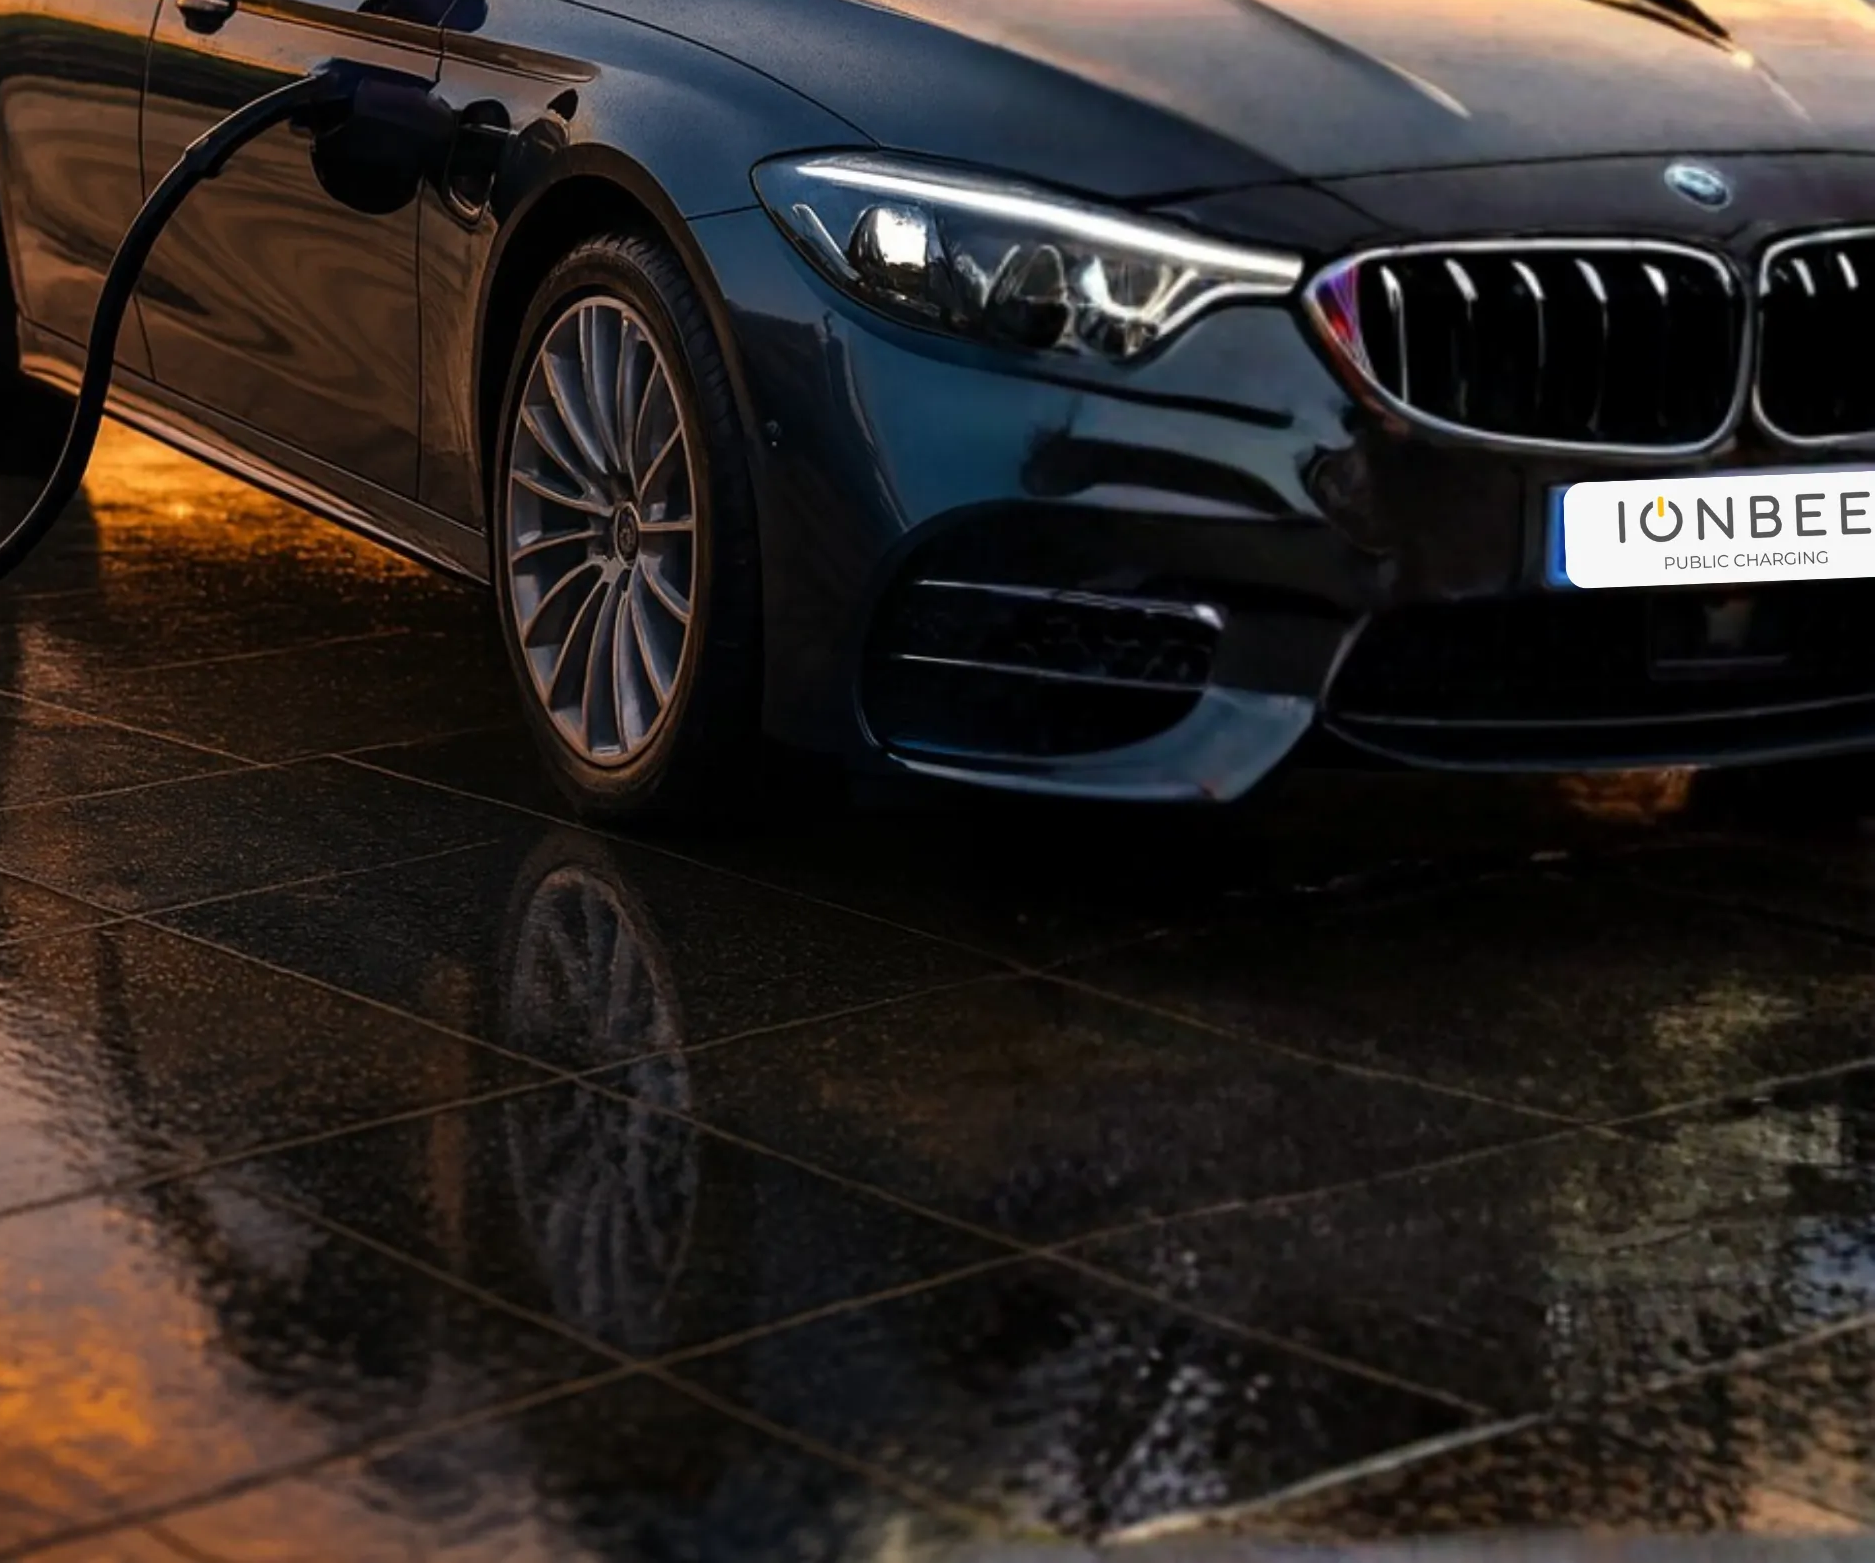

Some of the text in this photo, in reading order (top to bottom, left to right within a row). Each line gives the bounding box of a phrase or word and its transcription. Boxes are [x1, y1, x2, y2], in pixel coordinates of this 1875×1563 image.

[1617, 491, 1873, 544] IONBEE
[1664, 550, 1829, 570] PUBLIC CHARGING
